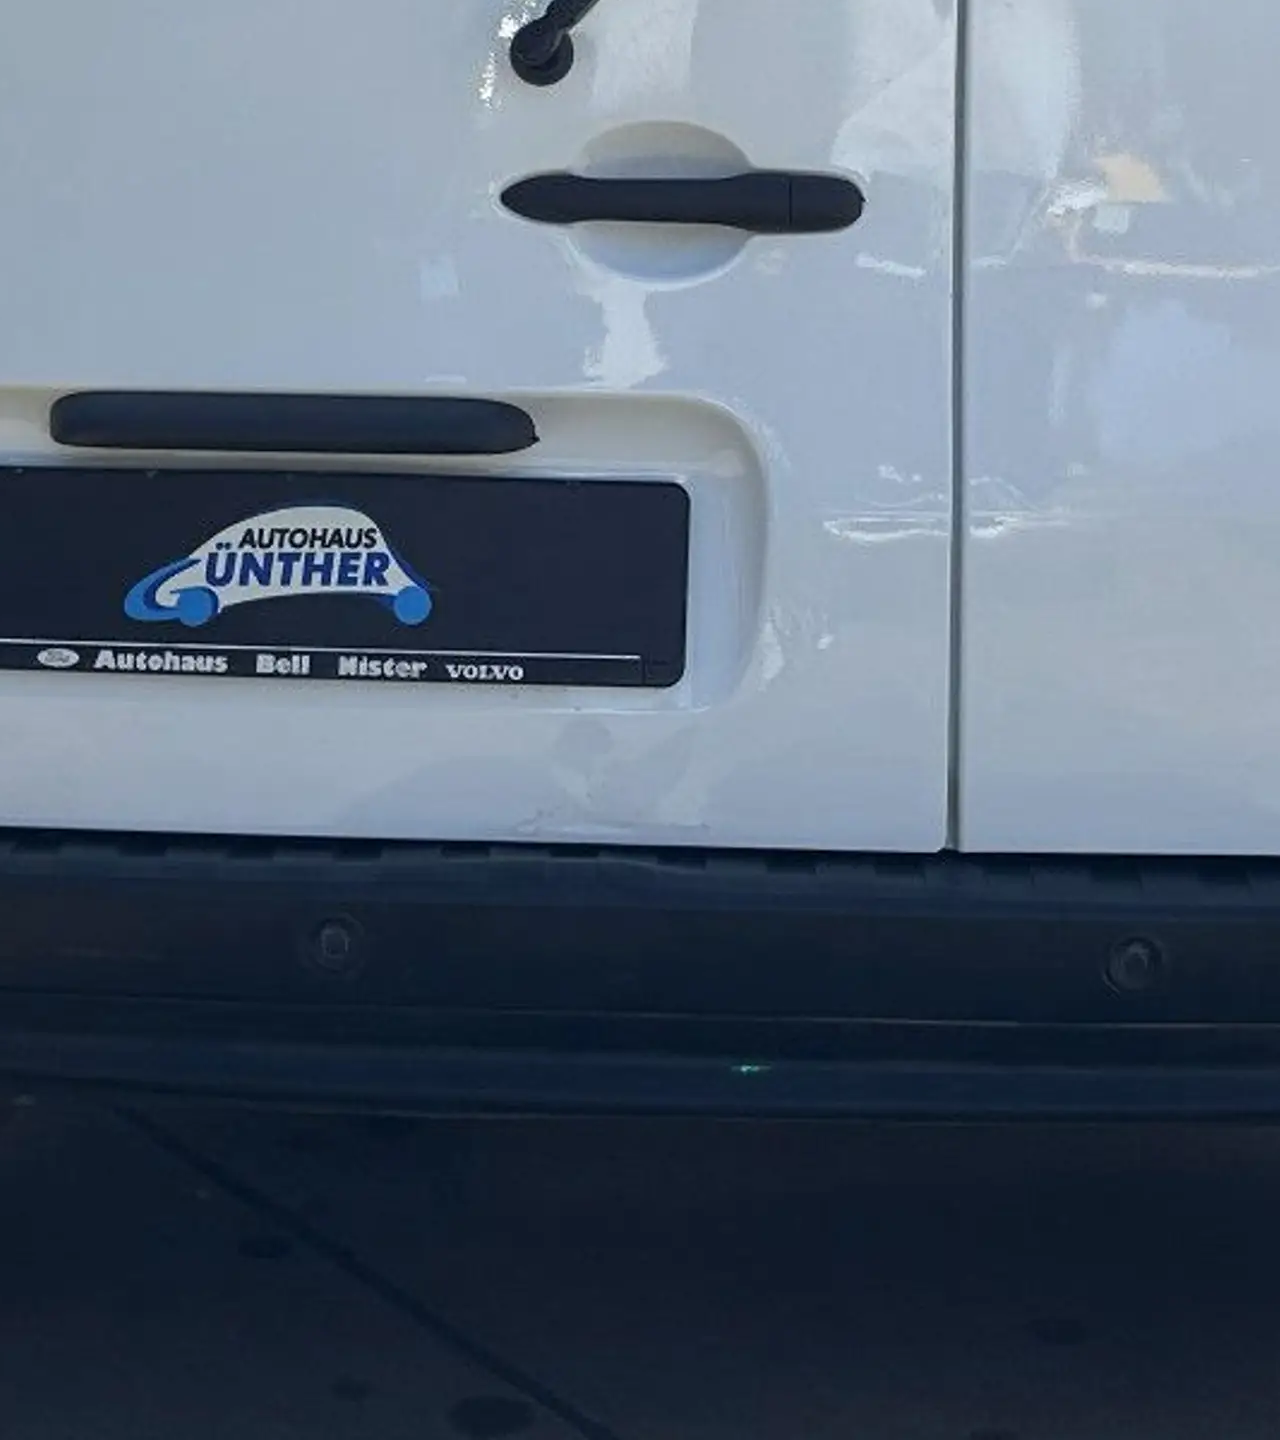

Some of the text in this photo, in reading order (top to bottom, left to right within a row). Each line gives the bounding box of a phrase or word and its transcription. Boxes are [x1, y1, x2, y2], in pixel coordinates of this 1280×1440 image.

[238, 527, 378, 549] AUTOHAUS
[93, 649, 229, 673] Autohaus
[255, 653, 312, 675] Bell
[445, 663, 525, 681] VOLVO
